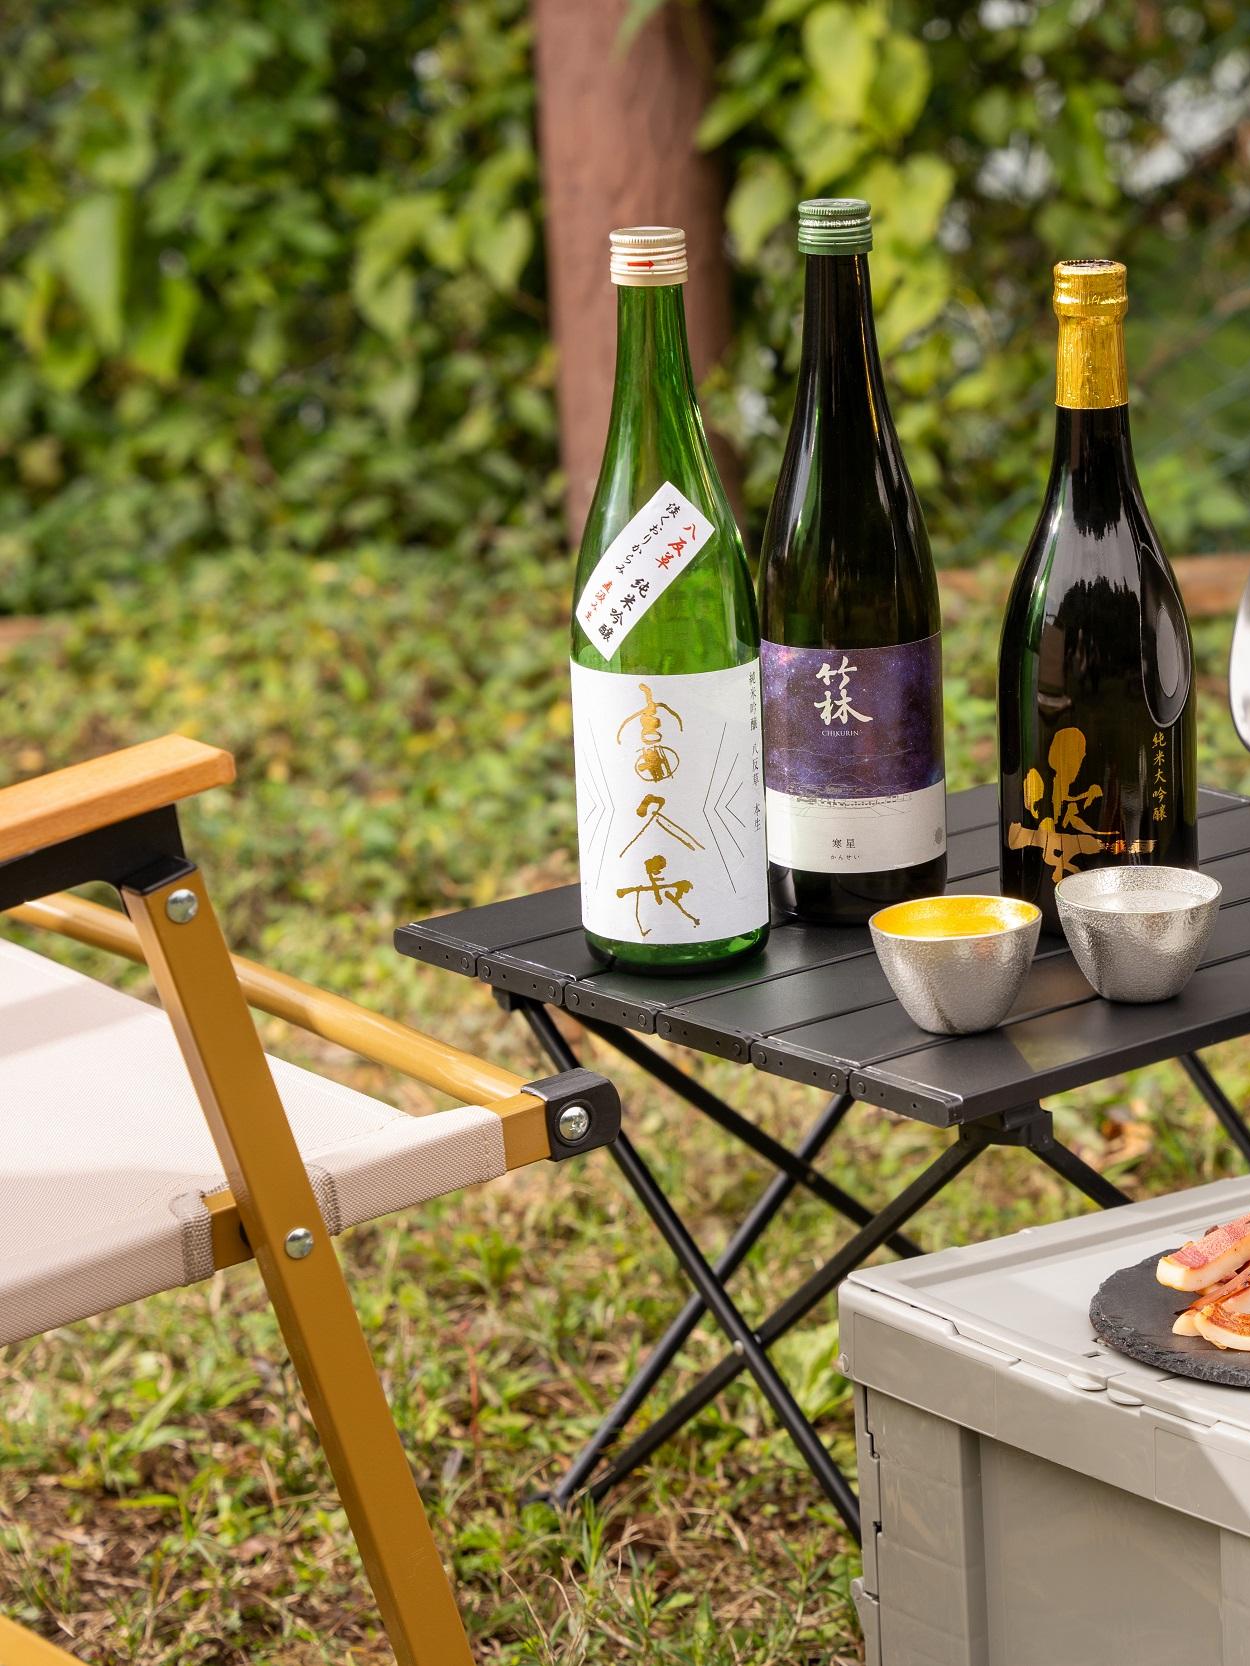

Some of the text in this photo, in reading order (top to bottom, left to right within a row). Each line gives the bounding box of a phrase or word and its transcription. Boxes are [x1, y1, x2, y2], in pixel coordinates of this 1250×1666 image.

[598, 522, 697, 642] 八反草 純米吟醸
[813, 656, 873, 726] 竹林
[821, 730, 859, 739] CHIKURIN
[616, 683, 706, 936] 富久長
[1152, 732, 1168, 822] 純米大吟醸
